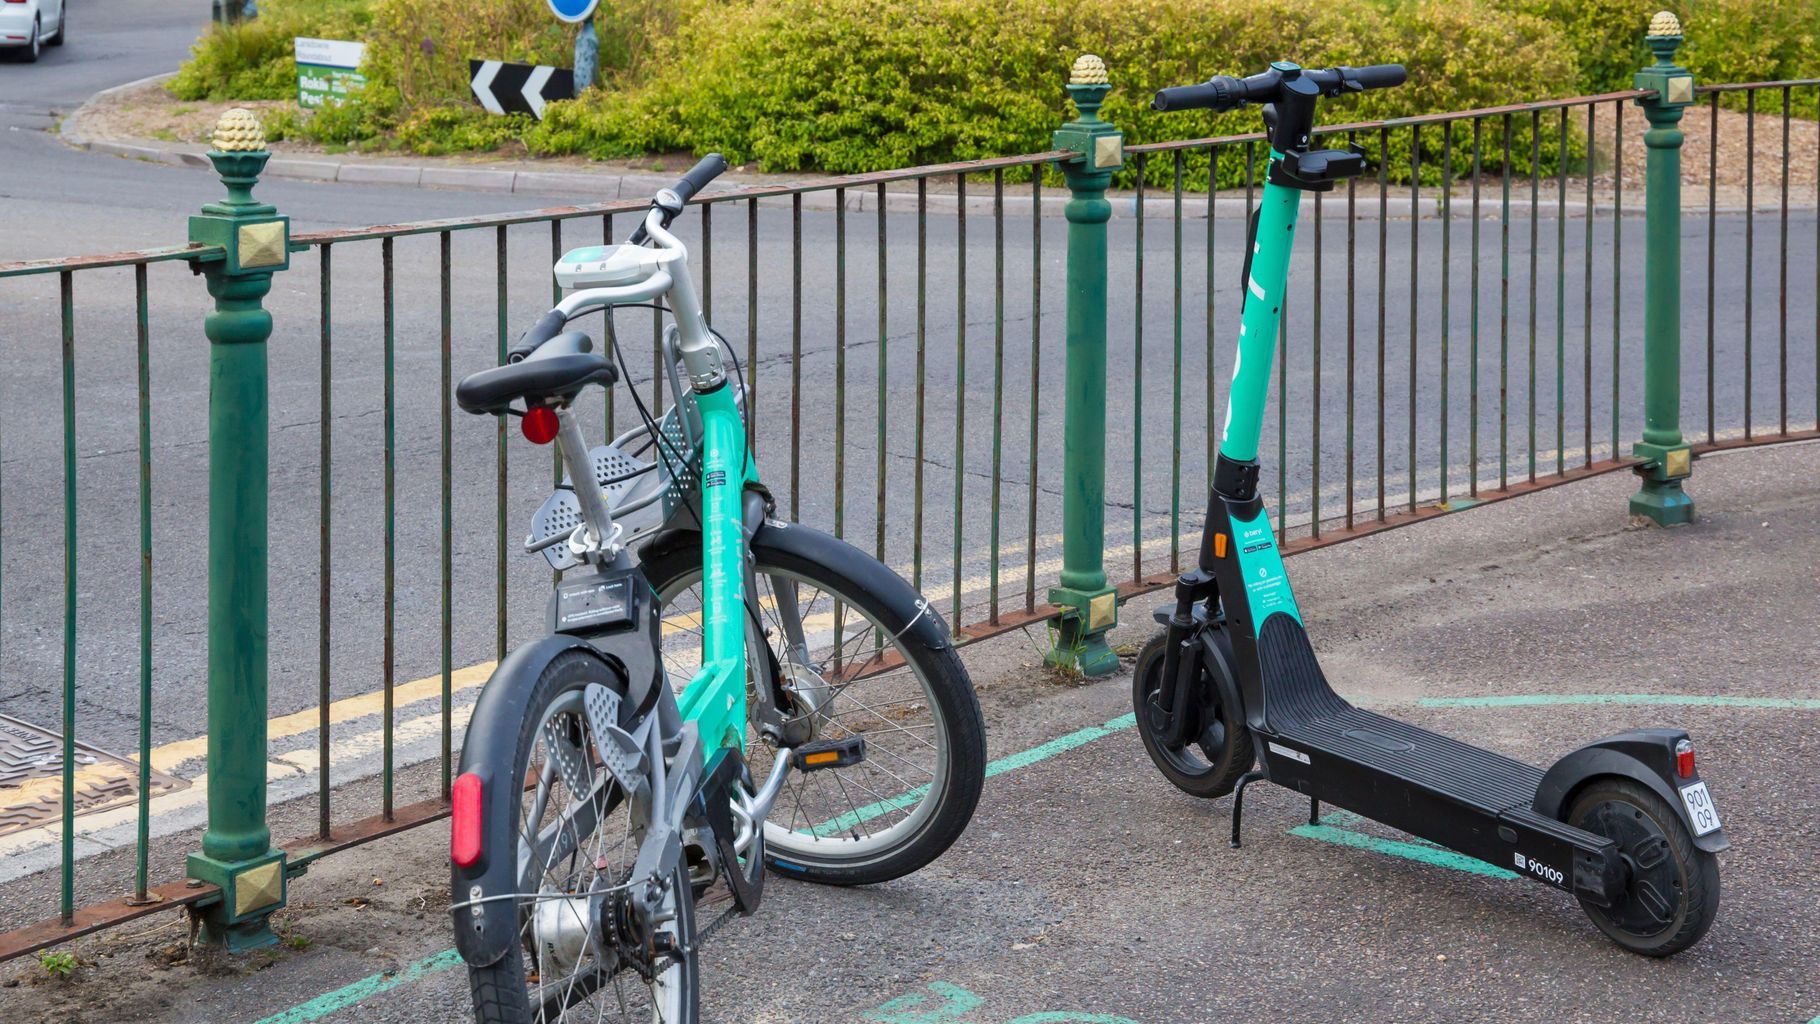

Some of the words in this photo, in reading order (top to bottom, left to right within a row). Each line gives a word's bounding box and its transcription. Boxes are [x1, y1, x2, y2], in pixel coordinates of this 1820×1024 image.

[1686, 788, 1709, 810] 901
[1697, 808, 1713, 829] 09
[1528, 859, 1564, 884] 90109
